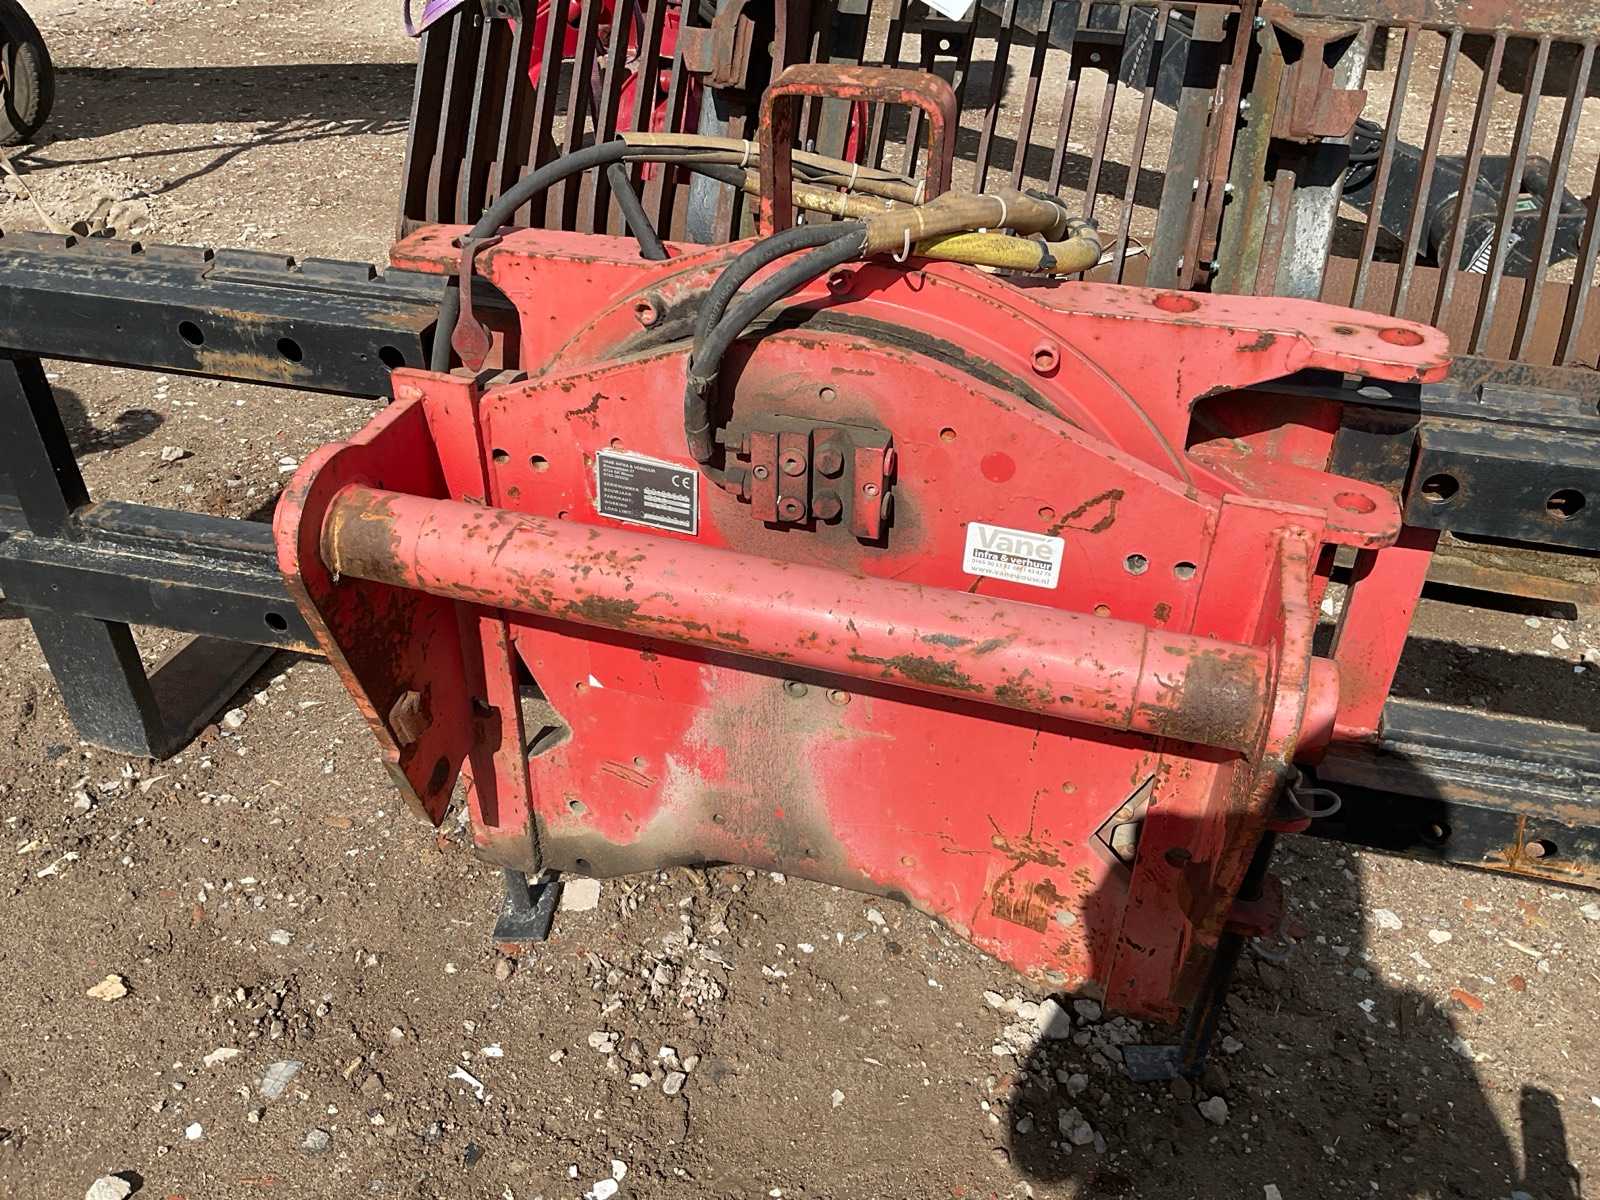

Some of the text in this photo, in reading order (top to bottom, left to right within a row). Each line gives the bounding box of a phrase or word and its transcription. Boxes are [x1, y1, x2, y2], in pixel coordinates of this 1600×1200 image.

[977, 526, 1053, 560] Vané
[974, 549, 998, 562] infra
[999, 553, 1009, 562] &
[1010, 556, 1053, 571] verhuur
